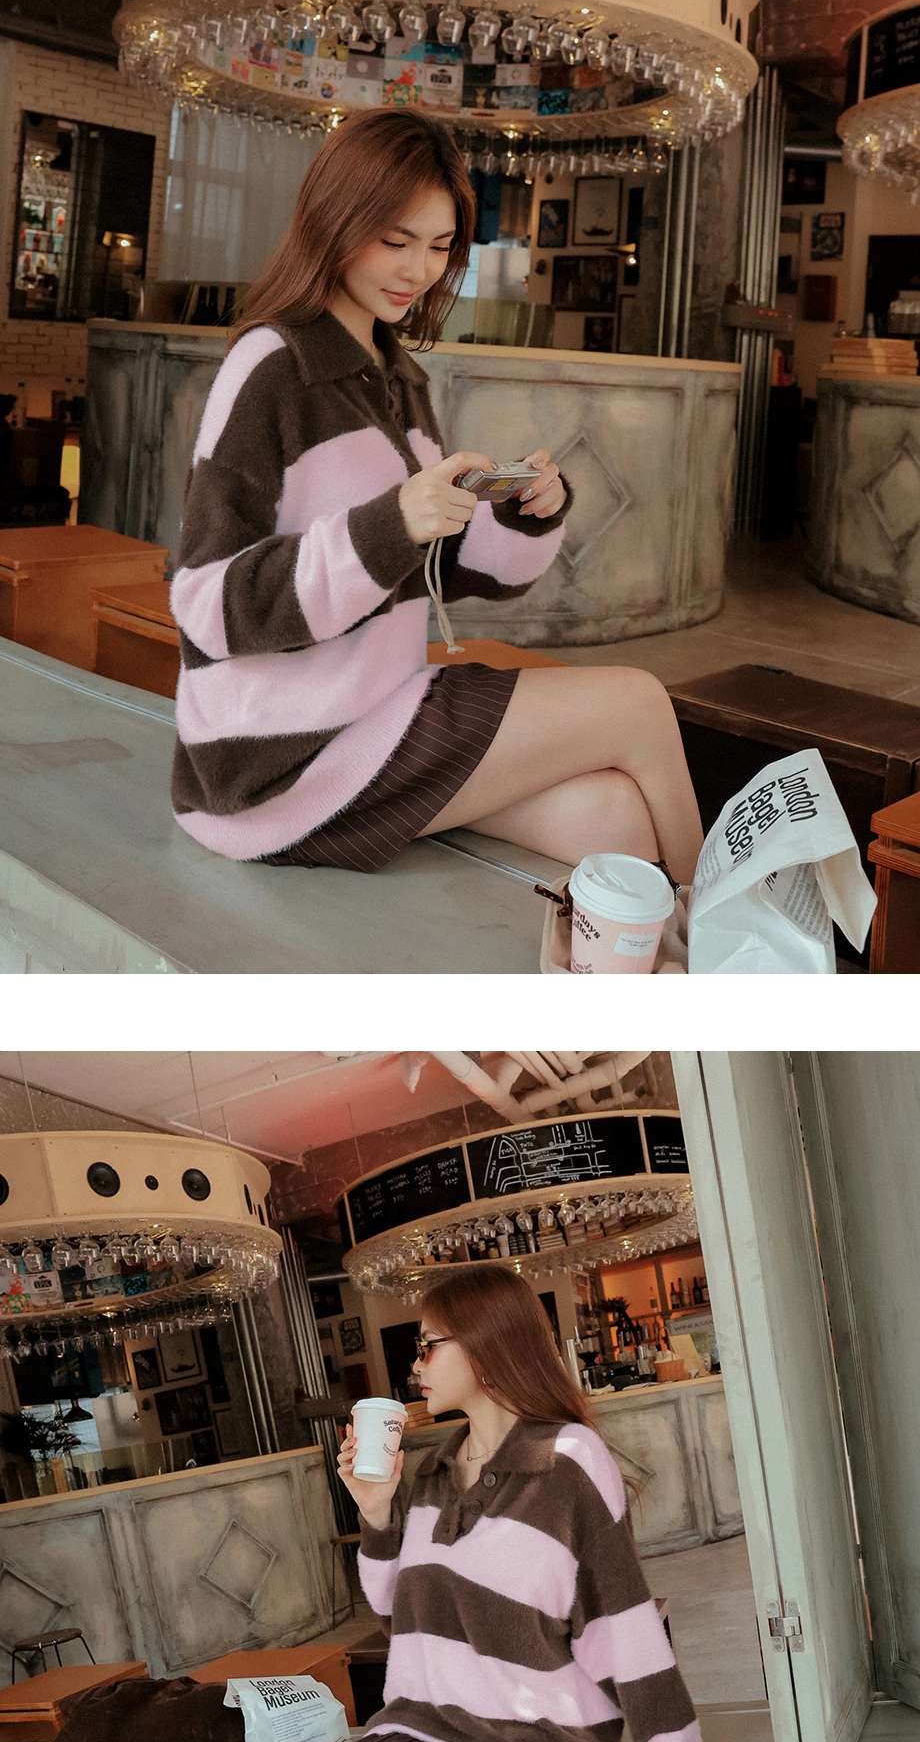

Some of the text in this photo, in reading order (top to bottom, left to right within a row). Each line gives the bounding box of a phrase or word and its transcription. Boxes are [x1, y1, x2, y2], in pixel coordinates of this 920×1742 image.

[778, 768, 820, 823] London
[748, 781, 786, 835] Bagel
[249, 1679, 296, 1688] London
[257, 1686, 294, 1696] Bagel
[263, 1690, 320, 1711] Museum
